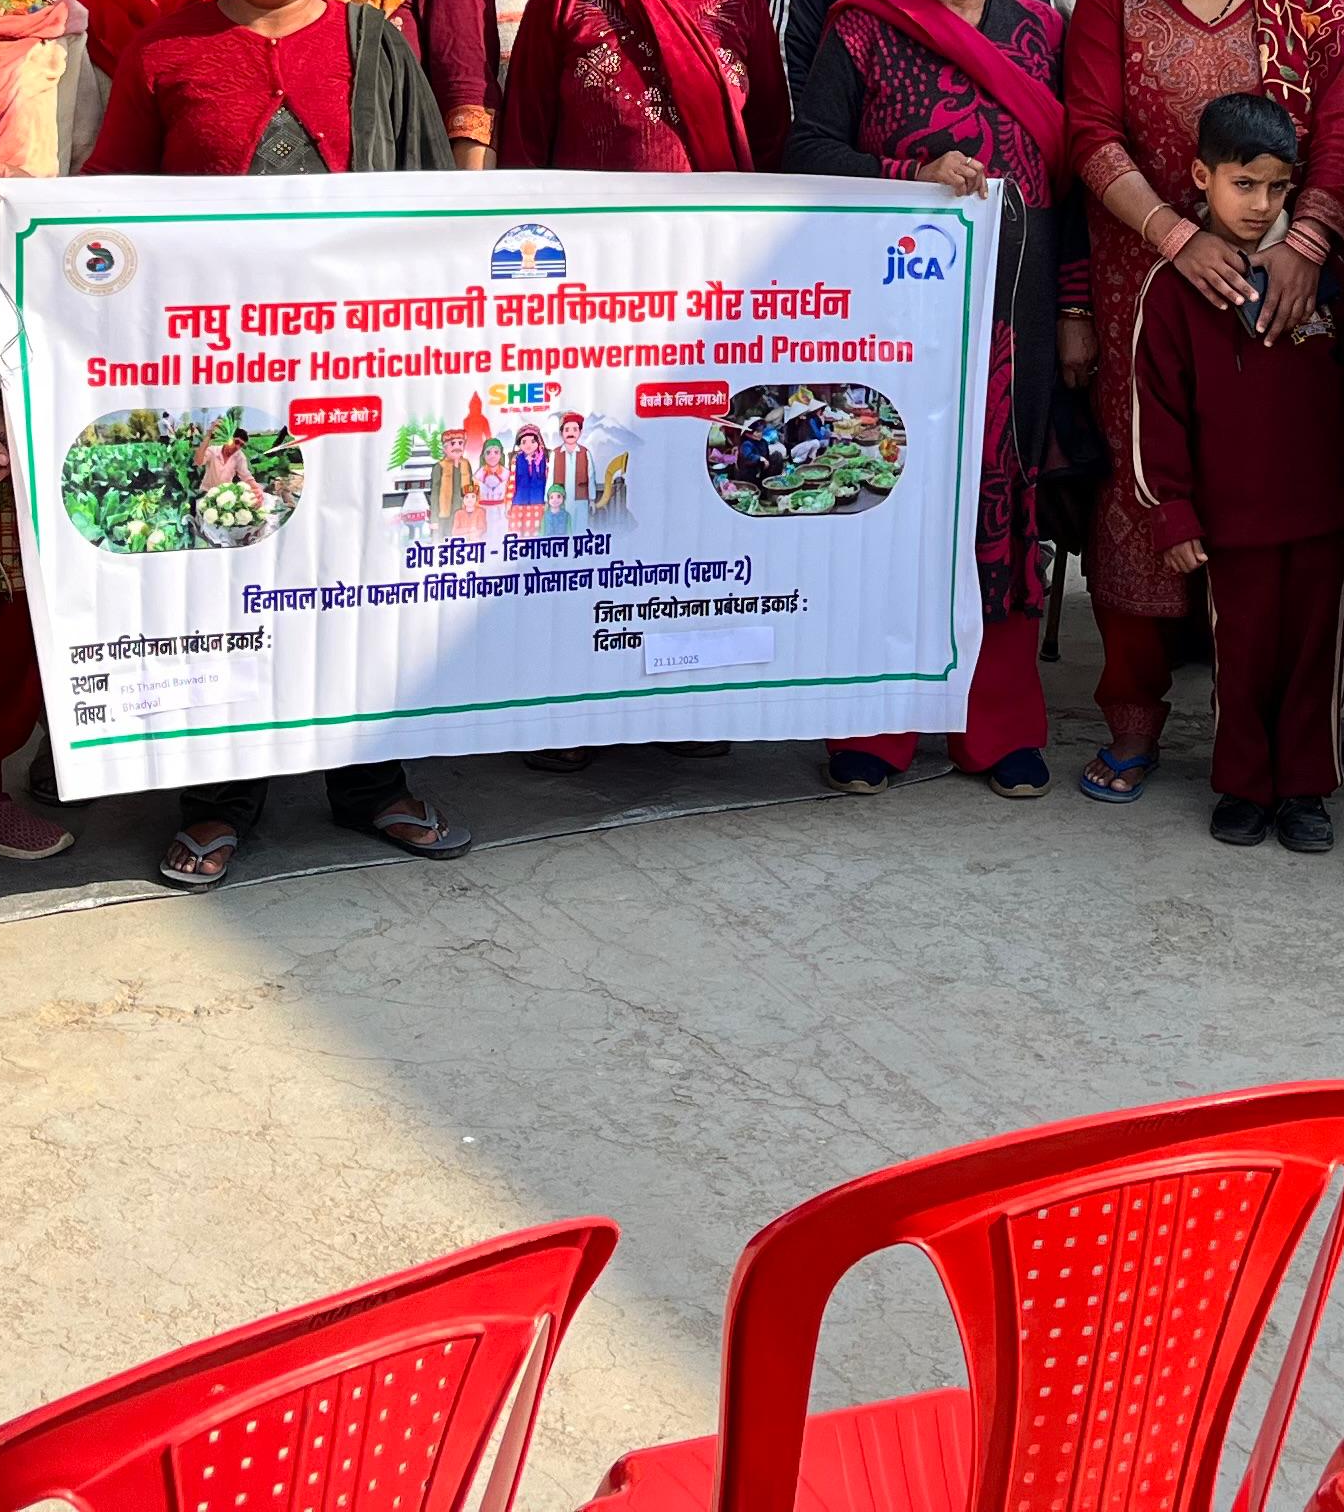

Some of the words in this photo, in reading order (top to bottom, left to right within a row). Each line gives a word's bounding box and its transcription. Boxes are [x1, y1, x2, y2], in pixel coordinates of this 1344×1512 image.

[165, 303, 232, 351] लघु
[241, 300, 337, 336] धारक
[344, 285, 486, 333] बागवानी
[493, 281, 678, 327] सशक्तिकरण
[686, 280, 744, 321] और
[751, 279, 851, 321] संवर्धन
[87, 354, 181, 387] Small
[192, 352, 302, 385] Holder
[310, 344, 492, 382] Horticulture
[500, 335, 706, 375] Empowerment
[713, 335, 764, 365] and
[771, 333, 914, 364] Promotion
[488, 381, 562, 405] SHEP
[663, 391, 673, 407] के
[675, 391, 694, 406] लिए
[293, 410, 326, 426] उगाओ
[328, 409, 348, 425] और
[406, 540, 434, 569] शेप
[438, 537, 486, 568] इंडिया
[503, 533, 569, 561] हिमाचल
[573, 529, 612, 559] प्रदेश
[242, 583, 317, 614] हिमाचल
[320, 580, 362, 612] प्रदेश
[367, 581, 420, 606] फसल
[423, 569, 521, 604] विविधीकरण
[524, 566, 594, 597] प्रोत्साहन
[598, 559, 681, 589] परियोजना
[684, 555, 753, 588] (चरण-2)
[593, 600, 634, 624] जिला
[636, 595, 711, 621] परियोजना
[713, 592, 760, 617] प्रबंधन
[761, 589, 800, 616] इकाई
[70, 642, 106, 664] खण्ड
[108, 634, 178, 660] परियोजना
[180, 630, 224, 654] प्रबंधन
[226, 625, 265, 653] इकाई
[593, 627, 644, 652] दिनांक
[653, 654, 700, 667] 21.11.2025
[70, 672, 111, 695] स्थान
[137, 681, 171, 693] Thandi
[209, 674, 219, 683] to
[74, 701, 107, 727] विषय
[122, 698, 161, 713] Bhadyal
